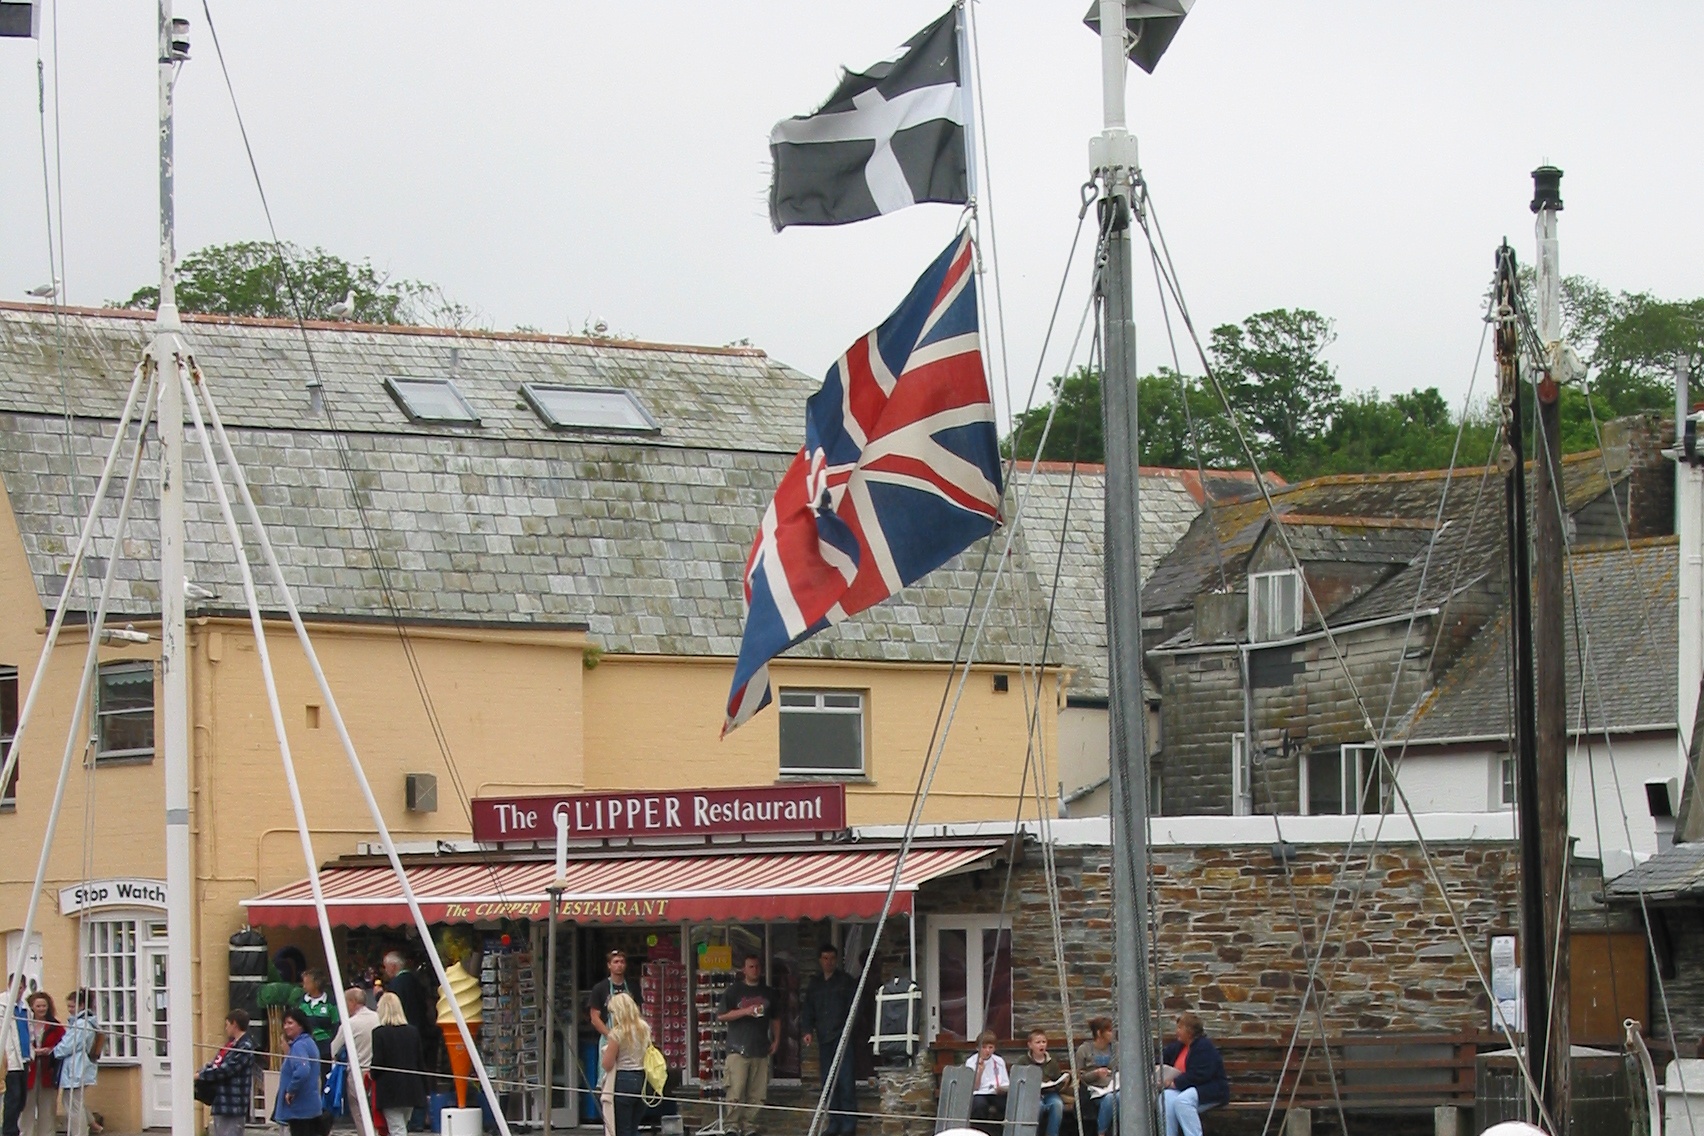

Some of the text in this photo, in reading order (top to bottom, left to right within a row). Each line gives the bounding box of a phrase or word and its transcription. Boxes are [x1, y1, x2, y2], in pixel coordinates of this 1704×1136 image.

[494, 803, 538, 834] The
[693, 796, 822, 828] Restaurant
[75, 884, 166, 904] Stop Watch
[445, 903, 470, 917] The
[475, 902, 542, 916] CLIPPER
